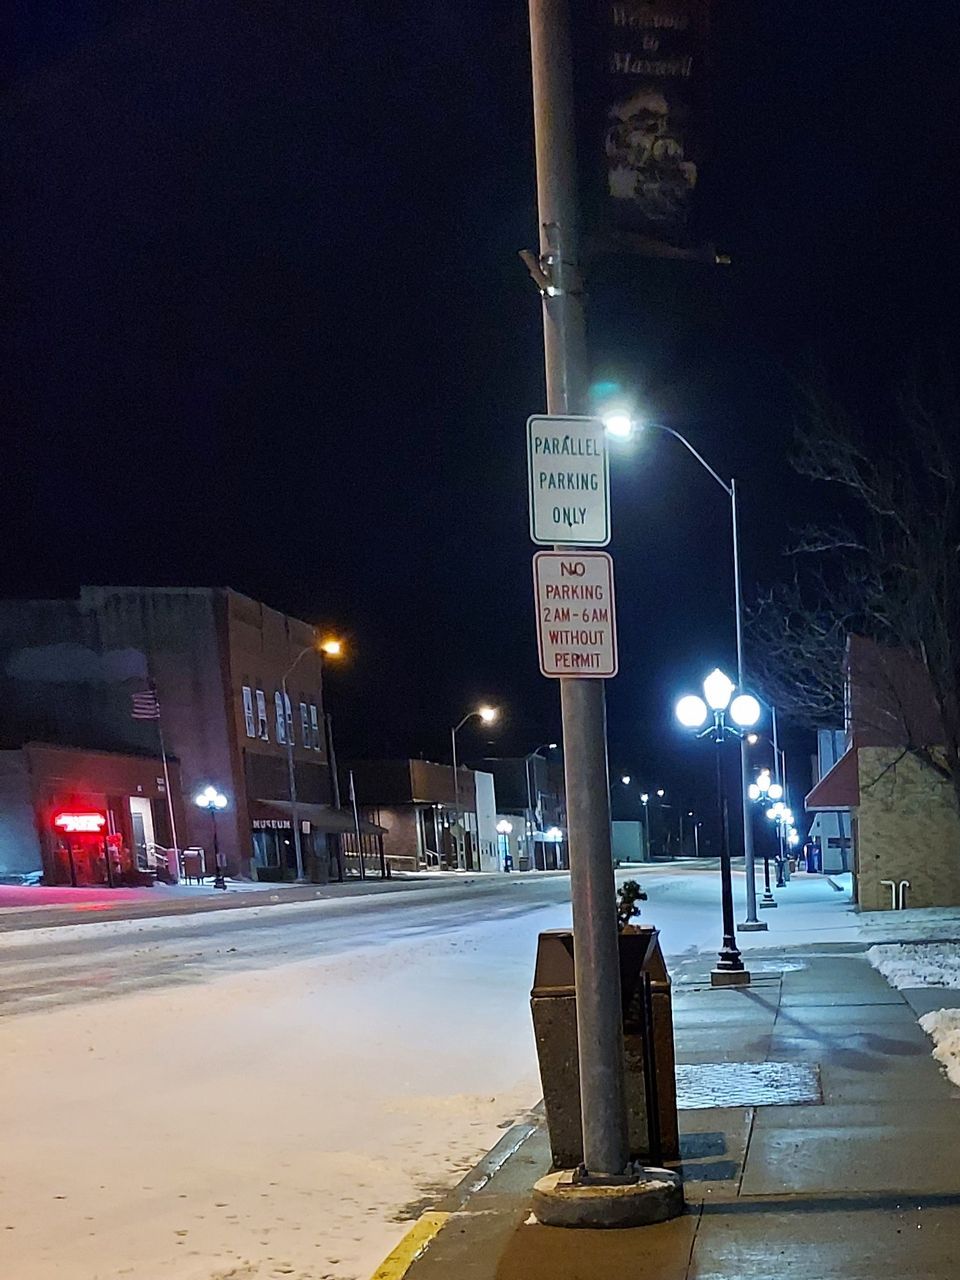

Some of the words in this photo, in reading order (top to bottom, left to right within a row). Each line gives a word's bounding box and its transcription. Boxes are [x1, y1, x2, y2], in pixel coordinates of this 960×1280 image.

[535, 437, 601, 456] PARALLEL
[539, 472, 598, 491] PARKING
[552, 507, 587, 525] ONLY
[560, 562, 586, 577] NO
[545, 585, 603, 600] PARKING
[548, 630, 605, 646] WITHOUT
[554, 653, 601, 669] PERMIT
[252, 819, 291, 829] MUSEUM
